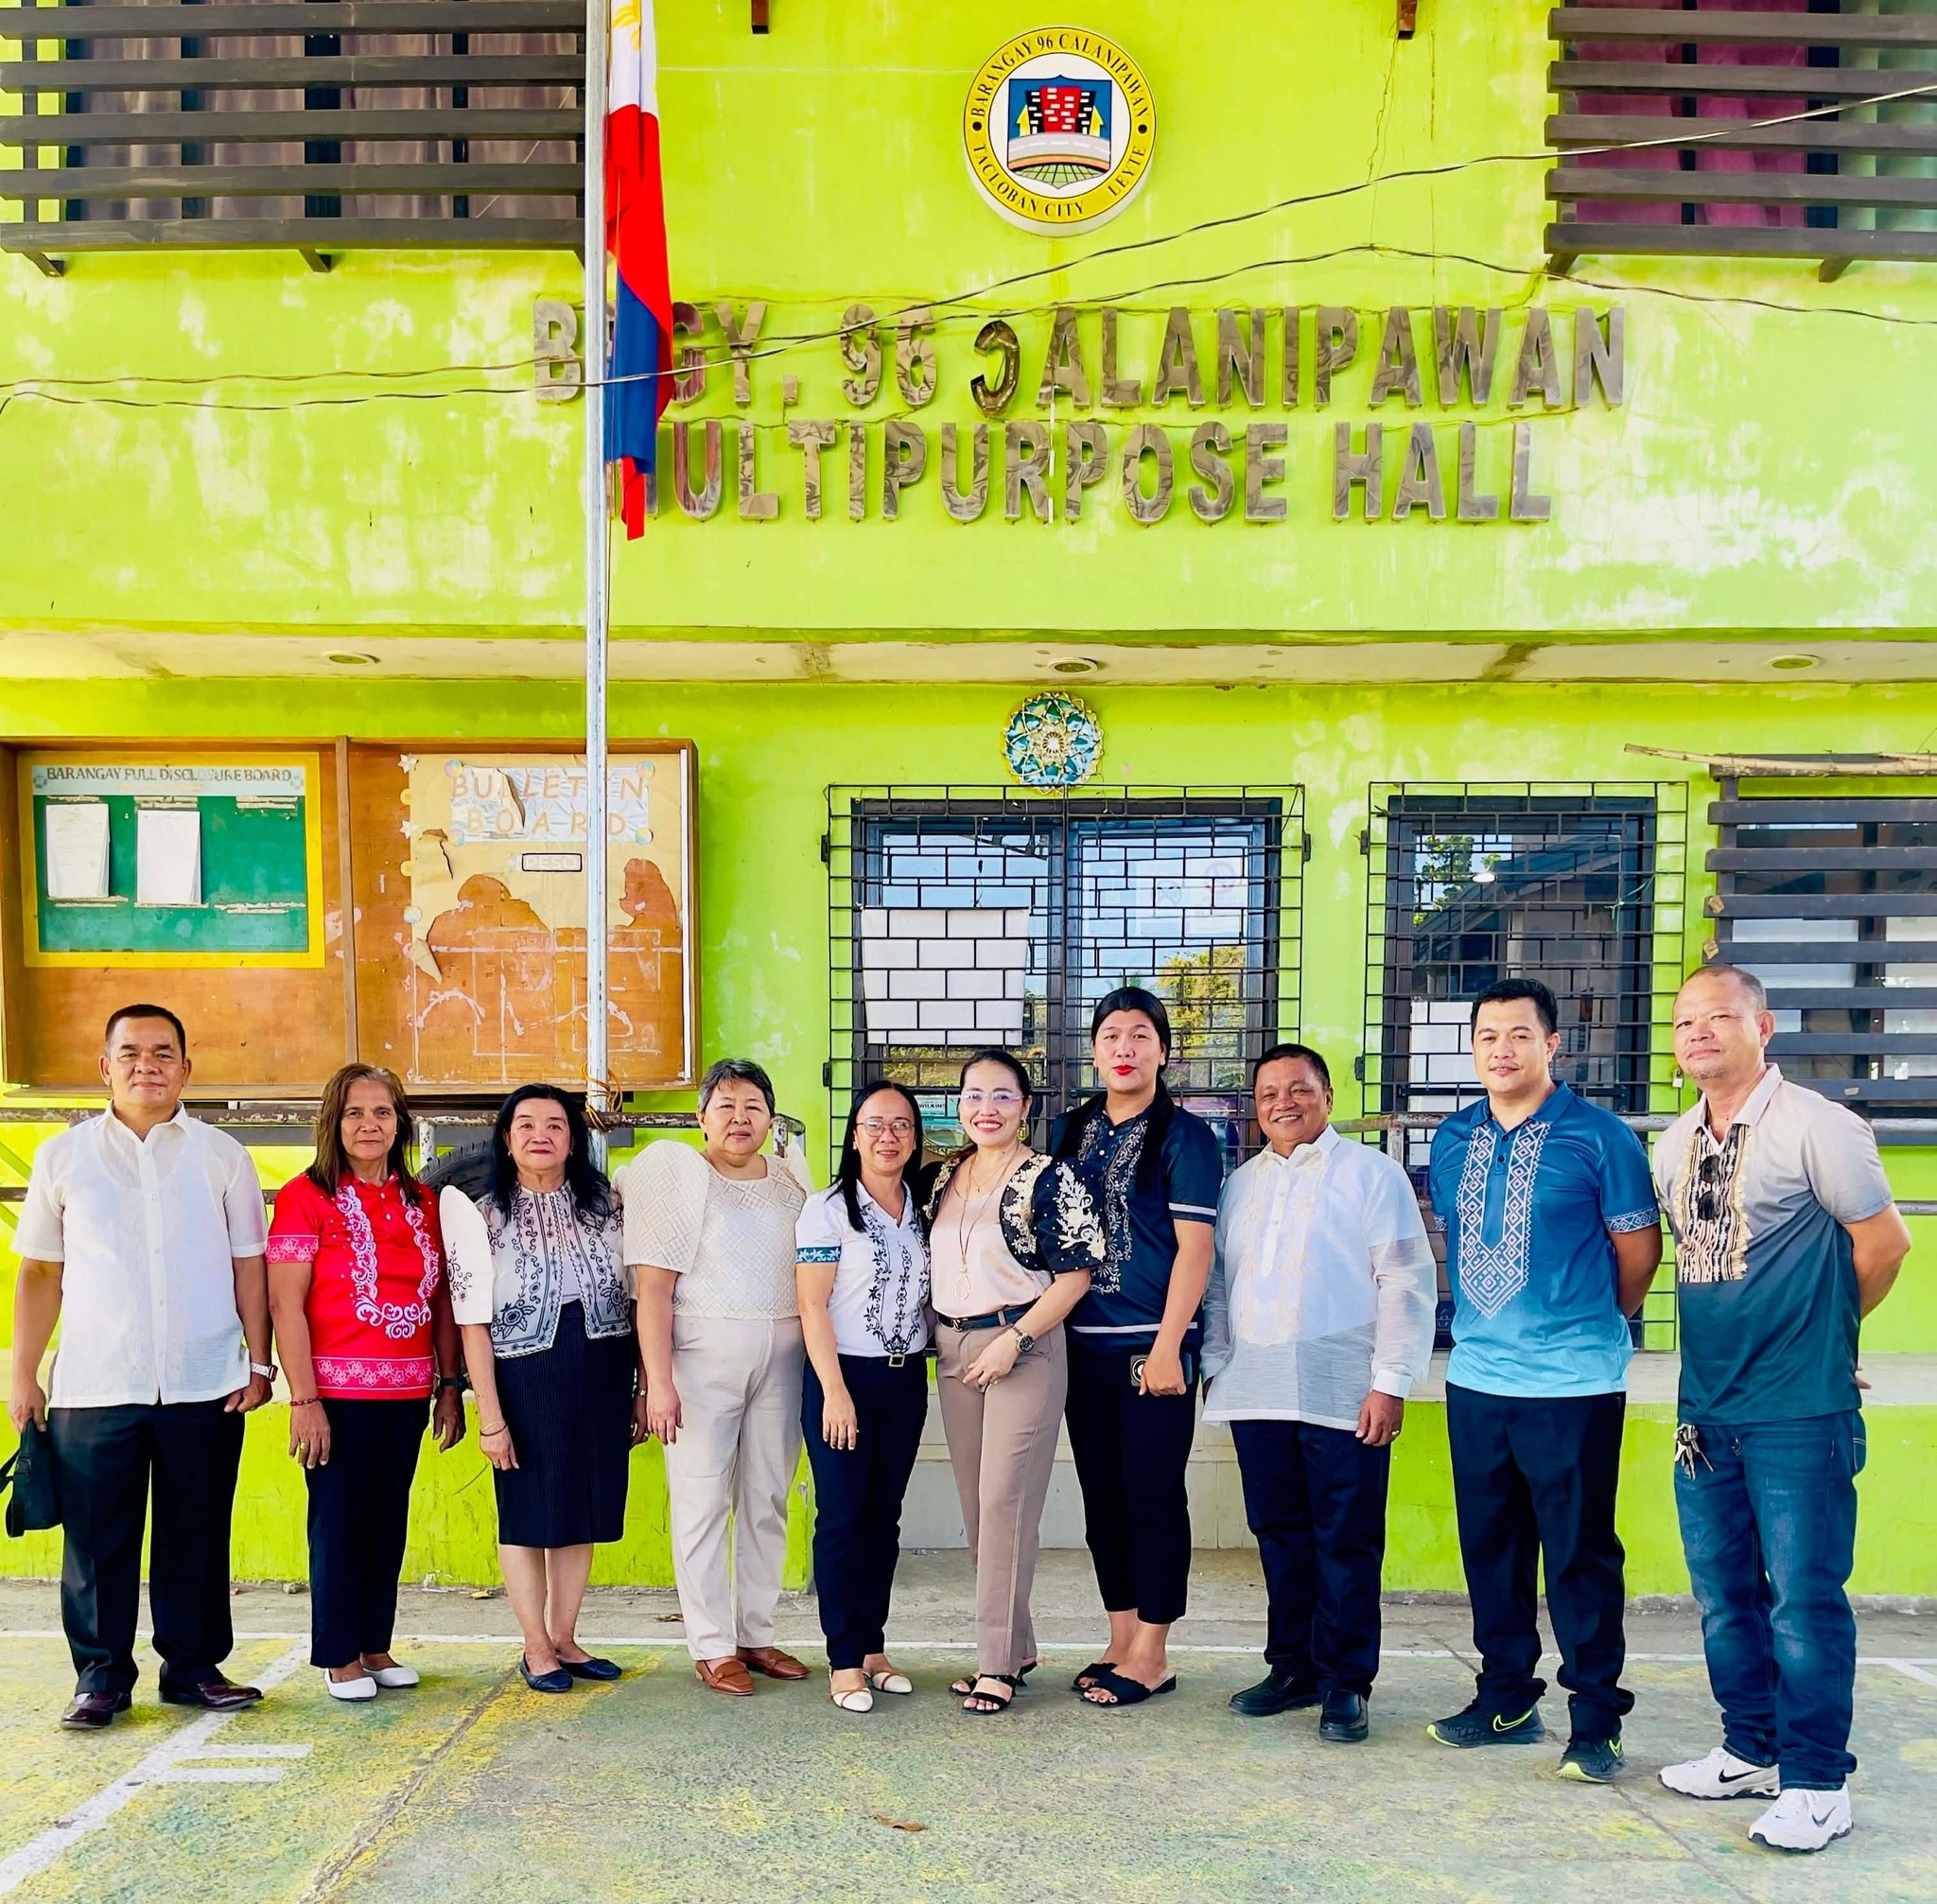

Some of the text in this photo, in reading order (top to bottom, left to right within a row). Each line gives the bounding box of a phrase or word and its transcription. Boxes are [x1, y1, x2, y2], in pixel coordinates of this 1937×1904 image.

[971, 33, 1150, 118] BARANGAY 96 CALANIPAWAN
[973, 143, 1146, 218] TACLOBAN CITY LEYTE
[532, 300, 799, 408] BGY.
[840, 303, 938, 410] 96
[606, 420, 1551, 524] ULTIPURPOSE HALL
[46, 767, 121, 780] BARANGAY
[124, 768, 157, 781] FULL
[244, 768, 292, 782] BOARD
[452, 773, 644, 800] BULLETN
[466, 808, 627, 835] BOARD
